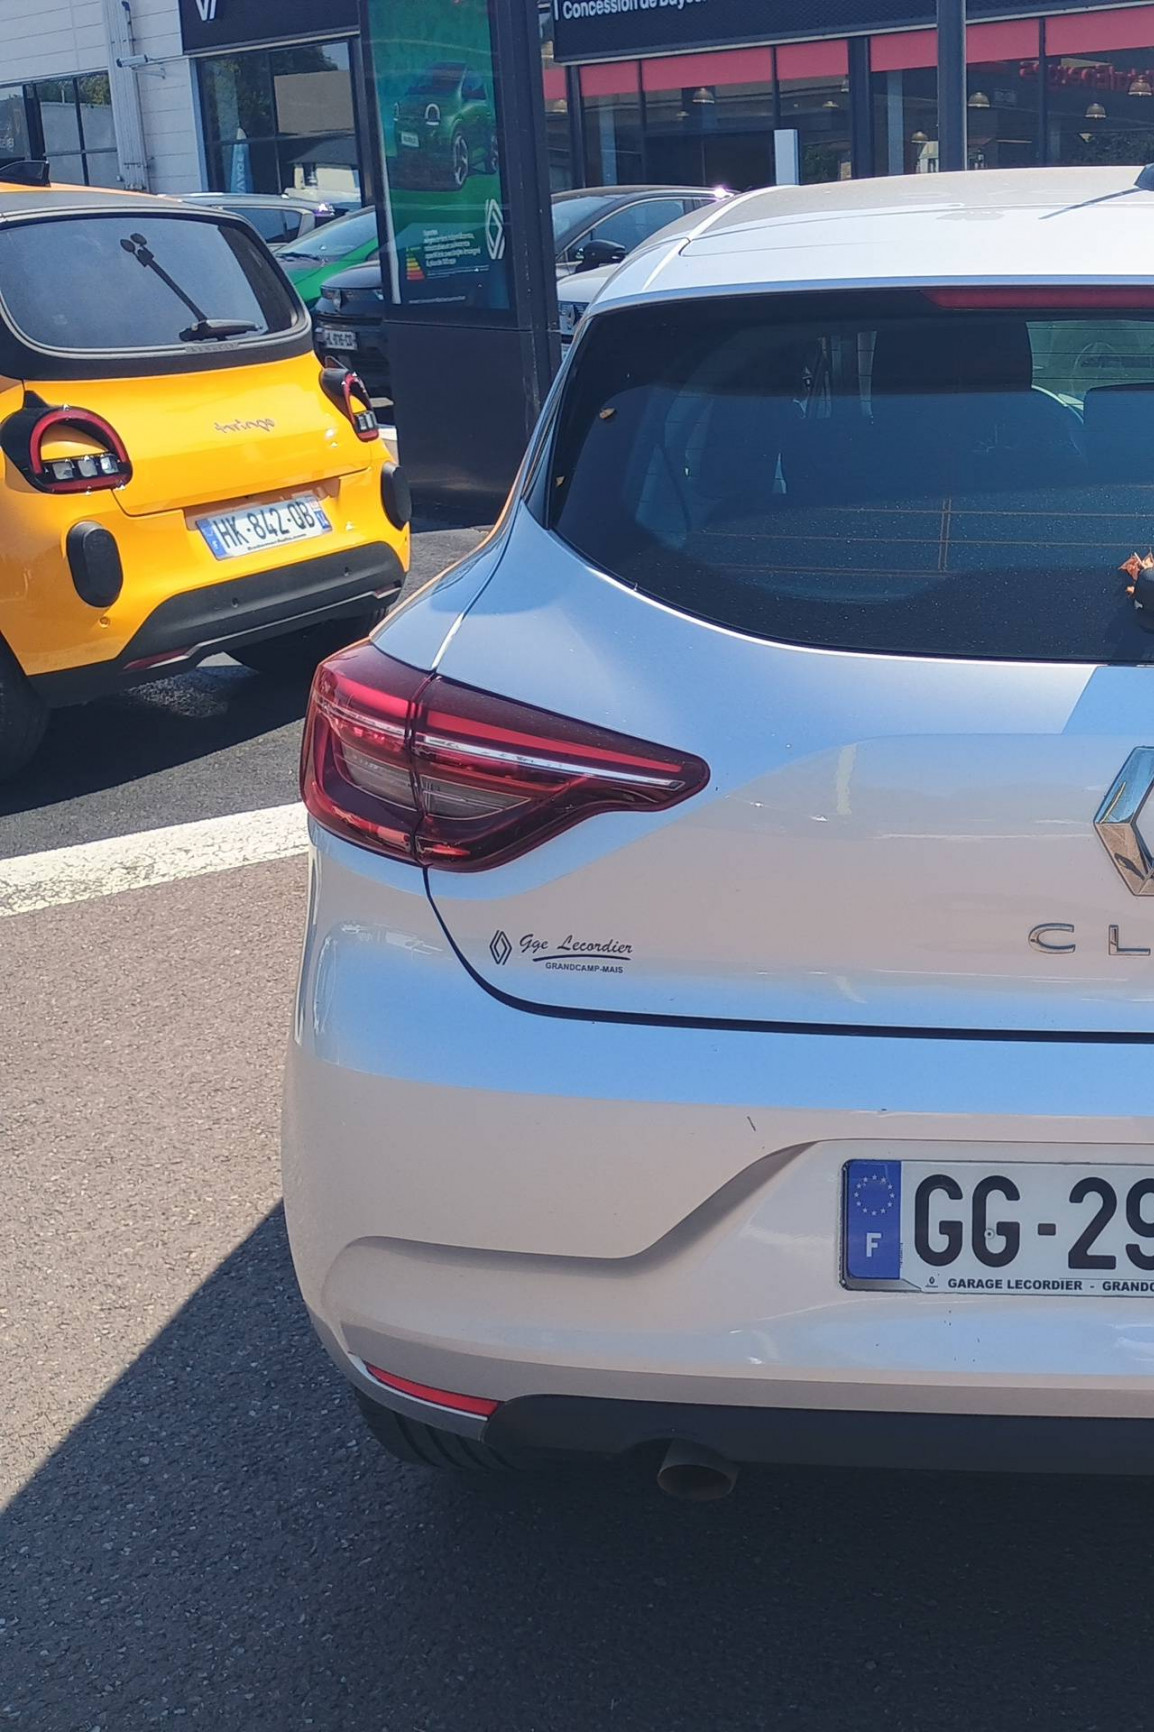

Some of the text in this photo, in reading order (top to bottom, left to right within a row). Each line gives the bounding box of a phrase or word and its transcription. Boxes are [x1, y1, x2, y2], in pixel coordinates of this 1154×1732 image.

[562, 0, 638, 20] Concession
[519, 933, 633, 954] Gge Lecordier
[545, 962, 624, 974] GRANDCAMP-MAIS
[865, 1232, 882, 1258] F
[947, 1278, 1003, 1290] GARAGE
[1007, 1279, 1083, 1291] LECORDIER
